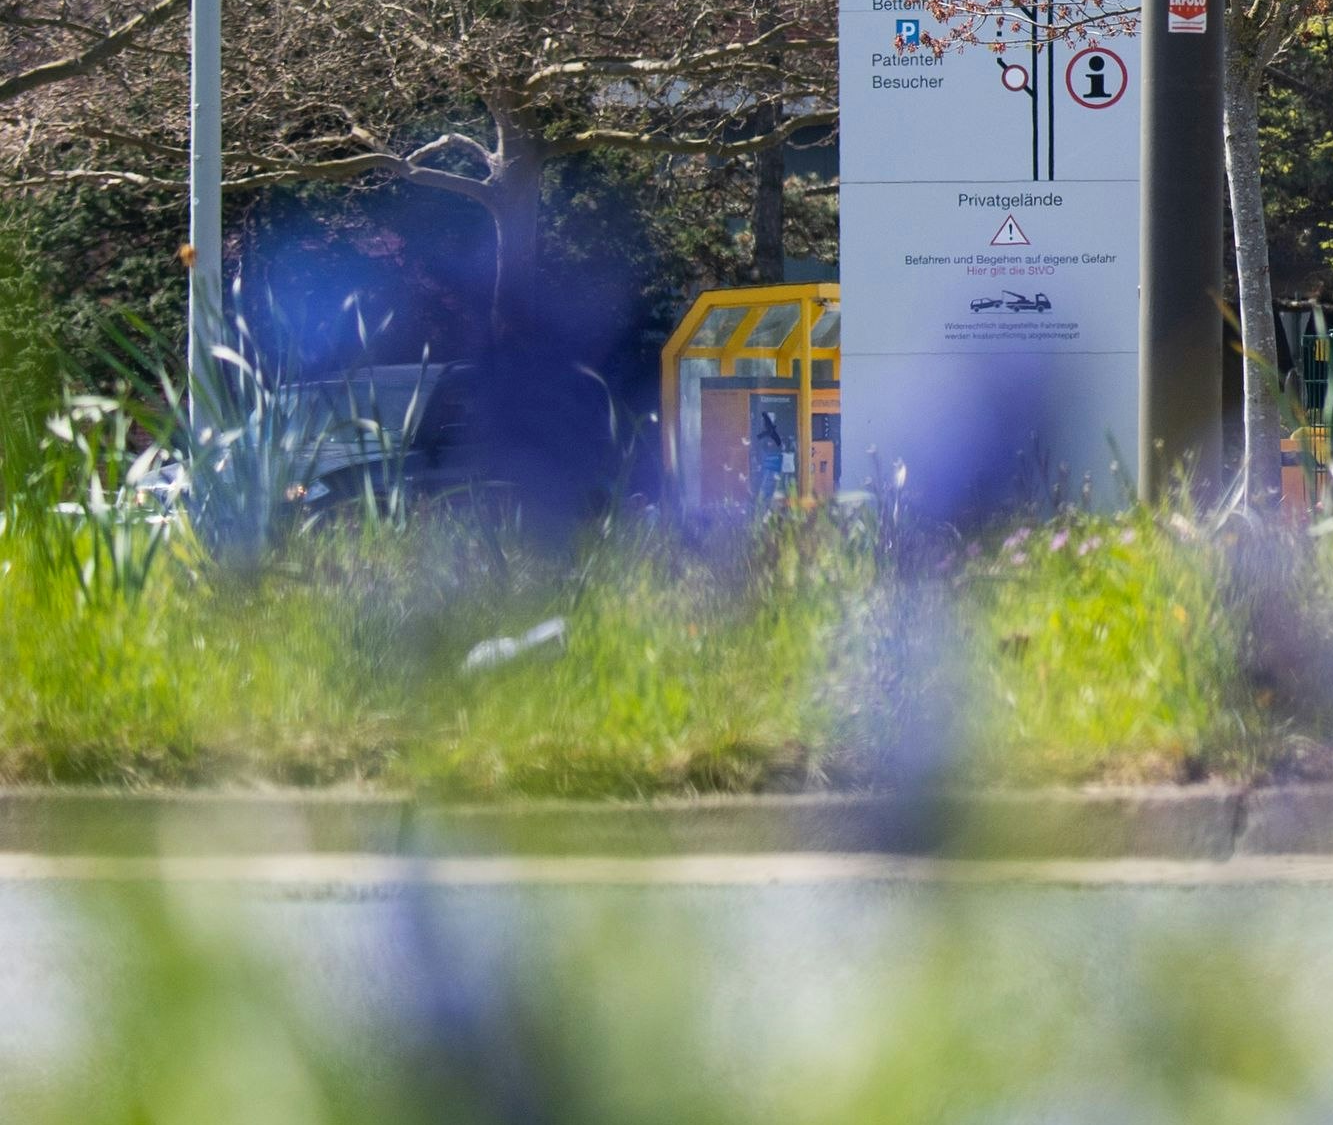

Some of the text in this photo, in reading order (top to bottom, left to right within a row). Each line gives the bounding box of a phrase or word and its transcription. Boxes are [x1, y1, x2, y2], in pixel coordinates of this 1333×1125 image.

[872, 53, 943, 67] Patienten
[872, 75, 943, 88] Besucher
[958, 193, 1063, 210] Privatgelände
[905, 254, 1117, 266] Befahren und Begehen auf eigene Gefahr
[966, 266, 987, 276] Hier
[1009, 266, 1025, 275] die
[1028, 265, 1055, 275] StVO
